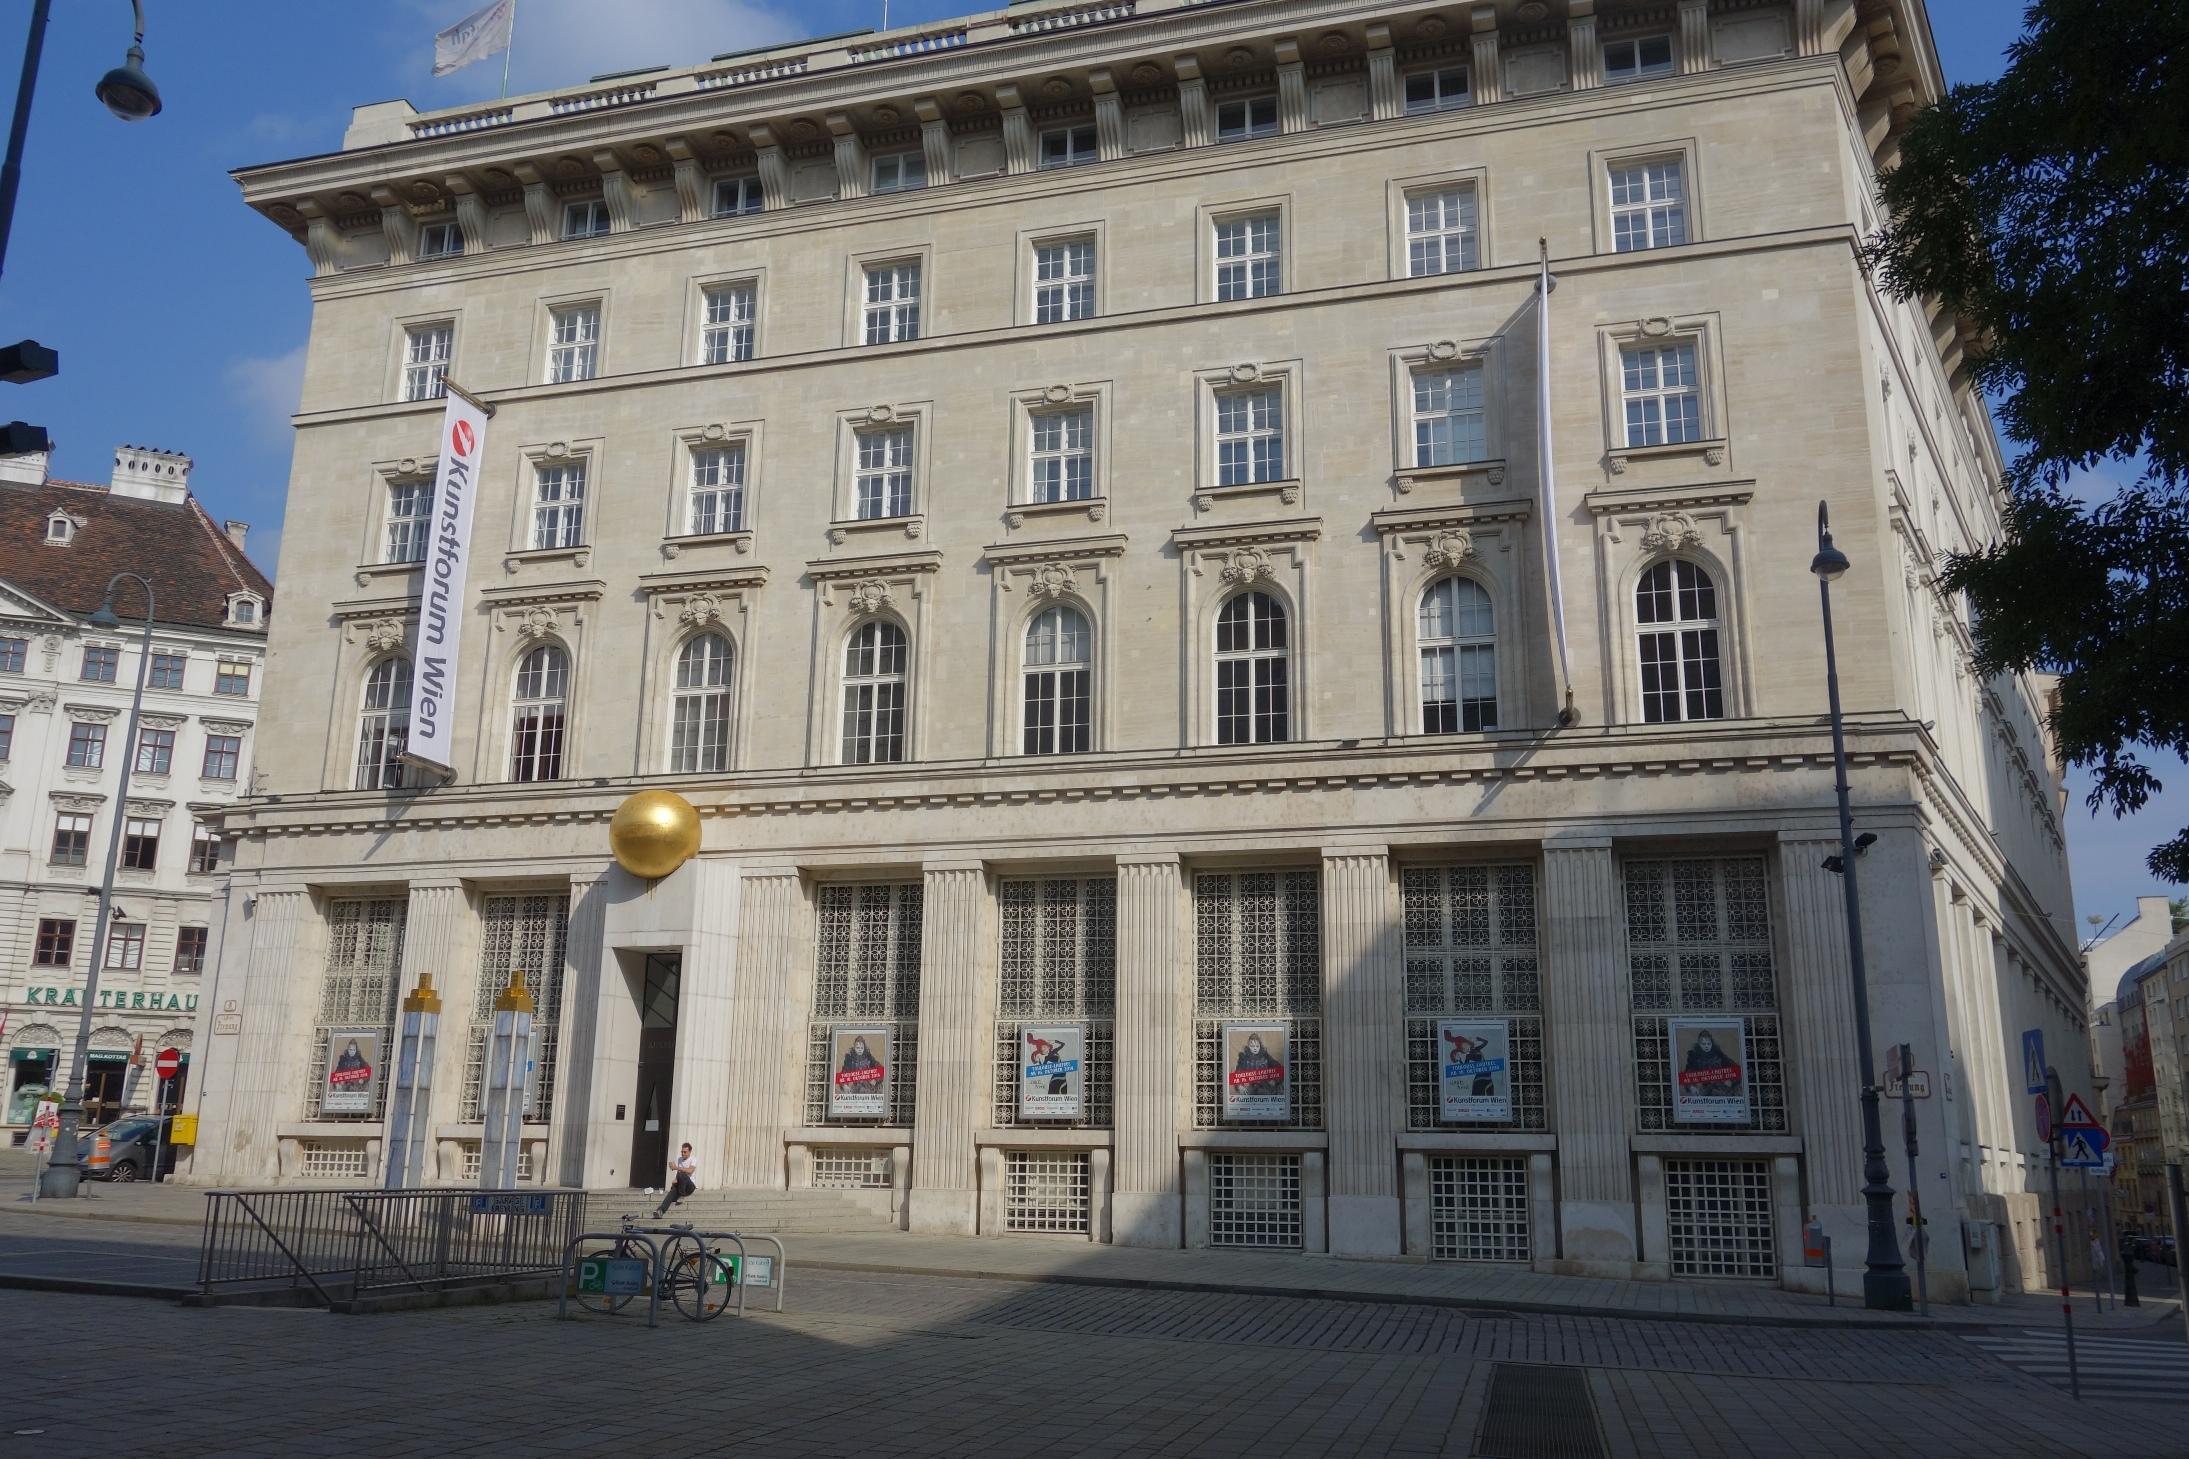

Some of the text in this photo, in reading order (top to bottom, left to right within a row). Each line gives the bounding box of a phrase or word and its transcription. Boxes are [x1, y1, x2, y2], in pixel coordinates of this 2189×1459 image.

[419, 455, 469, 739] Kunstforum Wien
[26, 986, 199, 1011] KRÄTERHAU
[1454, 1096, 1490, 1104] Kunstforum
[578, 1262, 599, 1289] P
